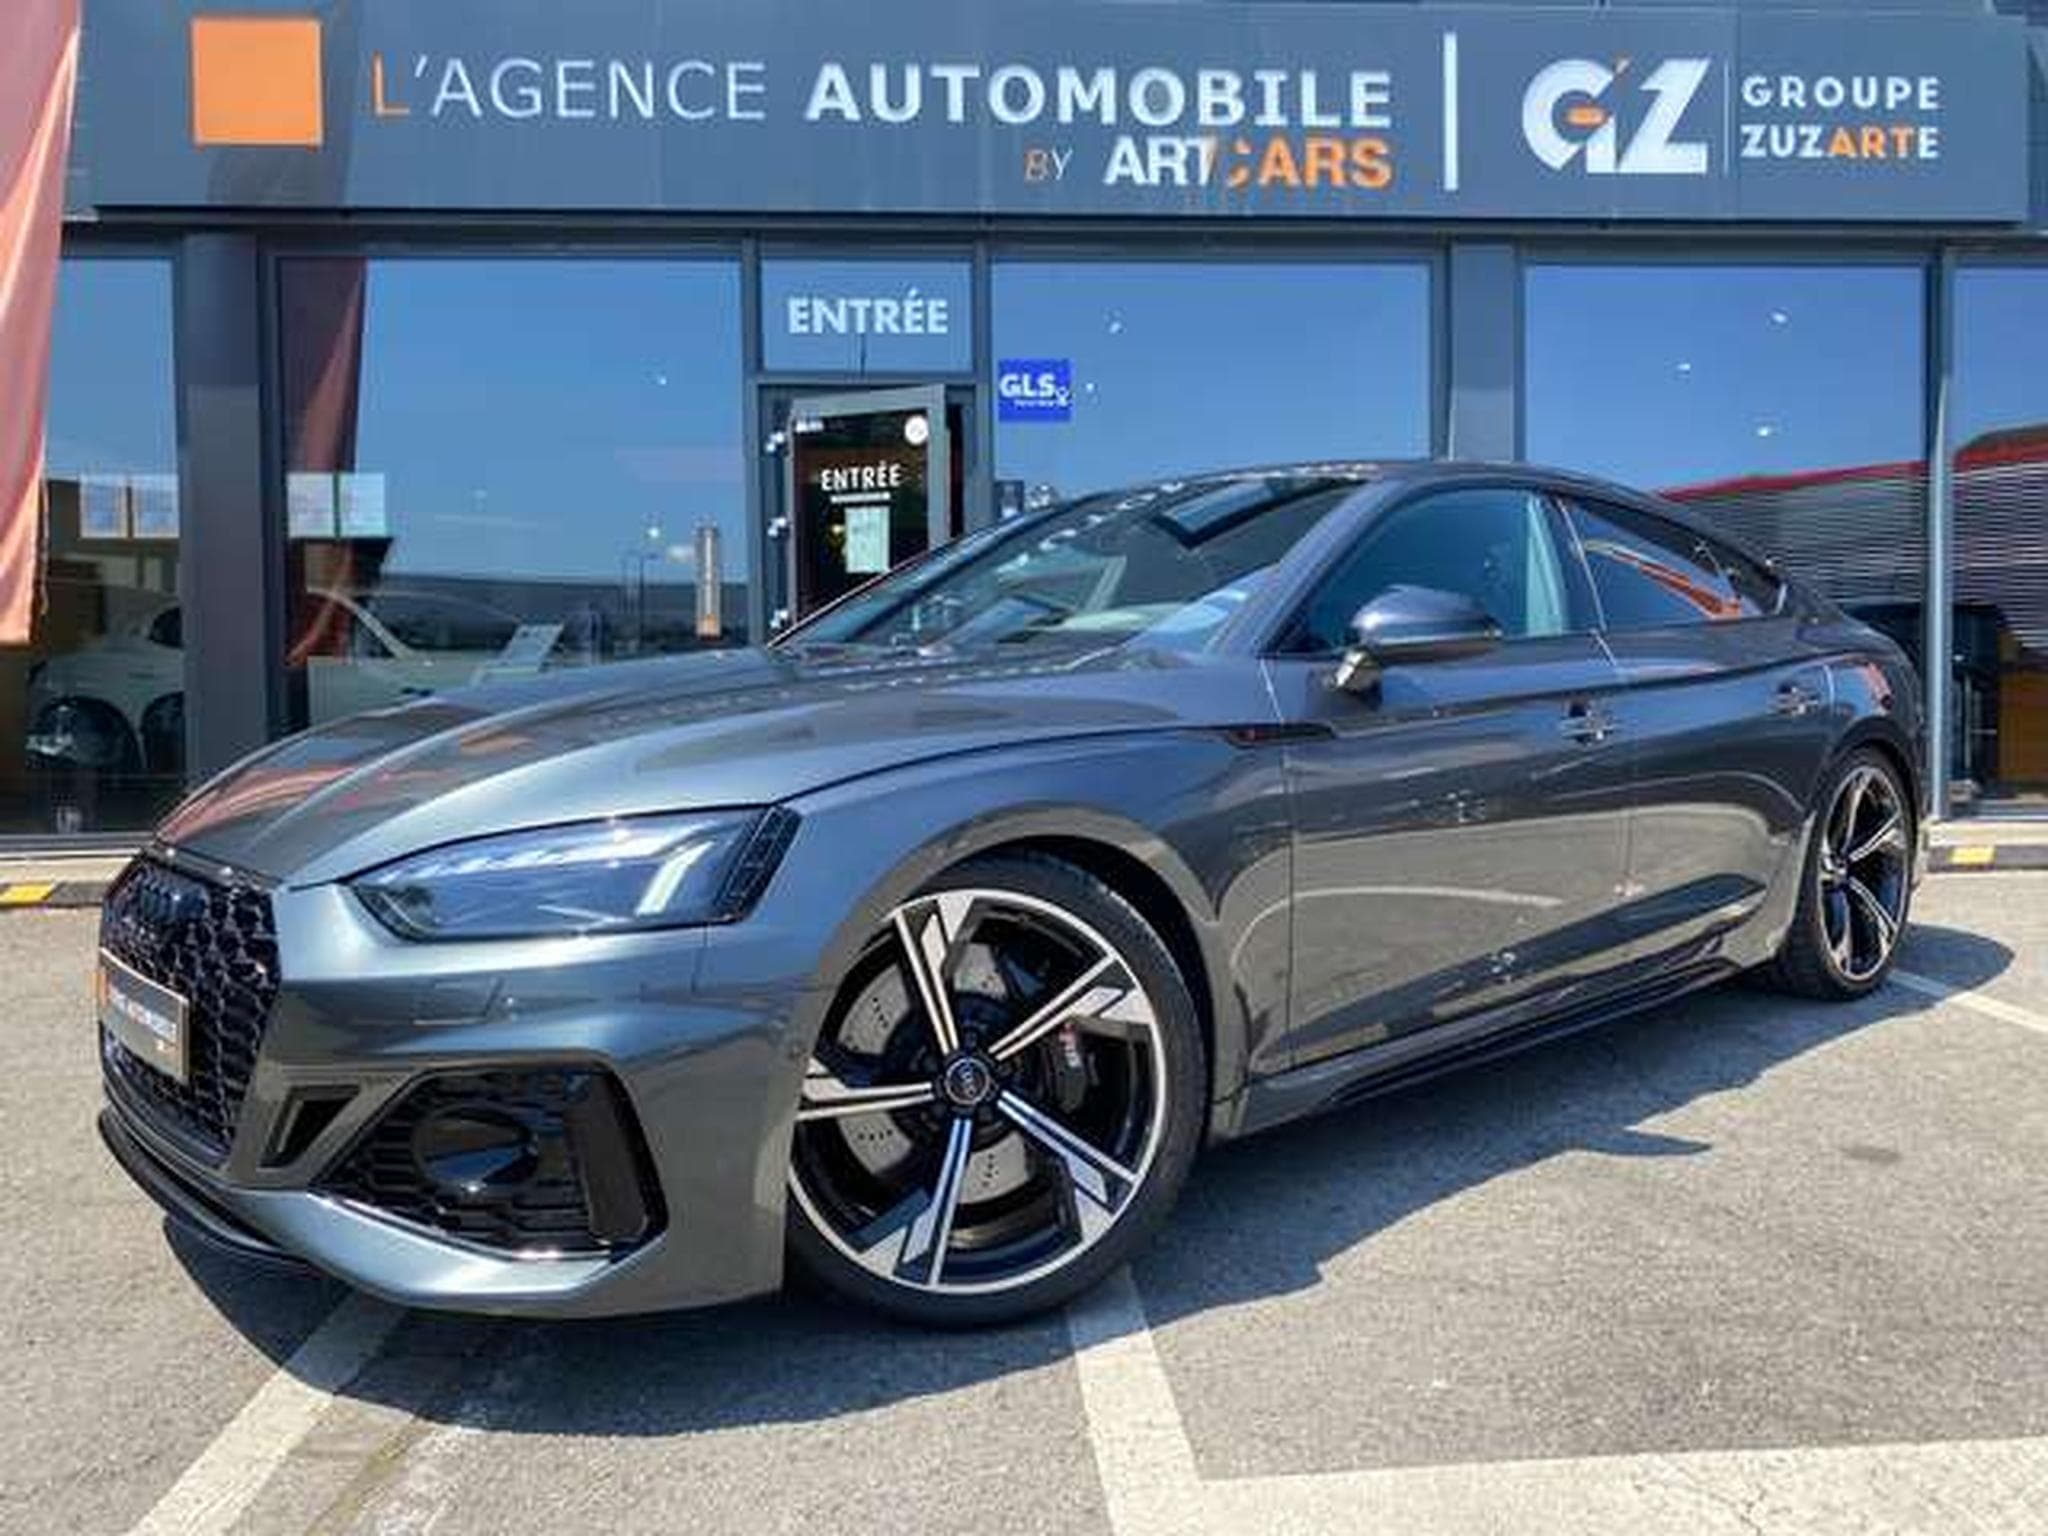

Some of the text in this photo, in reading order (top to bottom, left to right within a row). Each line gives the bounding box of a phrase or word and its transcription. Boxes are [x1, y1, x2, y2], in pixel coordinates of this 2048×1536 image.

[371, 51, 1391, 128] L'AGENCE AUTOMOBILE
[1741, 74, 1939, 110] GROUPE
[1740, 122, 1940, 160] ZUZARTE
[1024, 147, 1073, 181] BY
[788, 287, 948, 334] ENTRÉE
[1000, 373, 1055, 397] GLS
[821, 459, 902, 492] ENTRÉE
